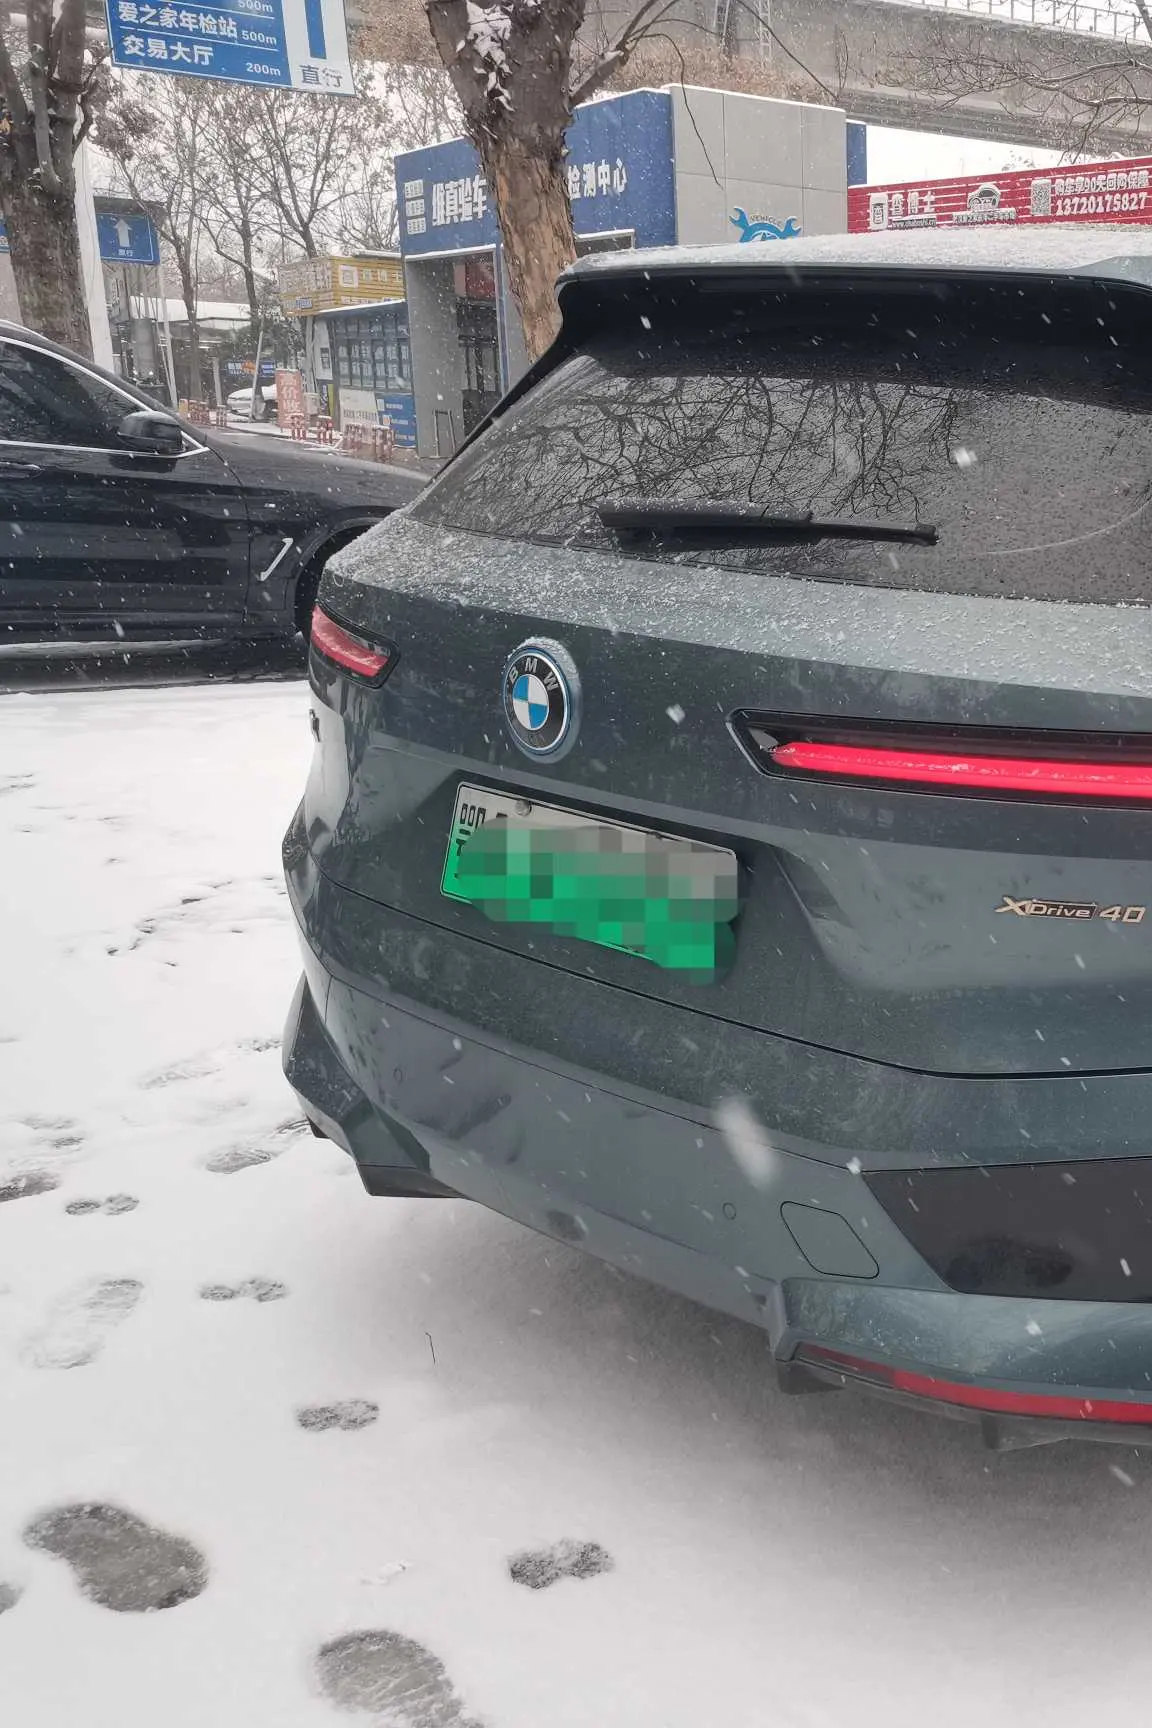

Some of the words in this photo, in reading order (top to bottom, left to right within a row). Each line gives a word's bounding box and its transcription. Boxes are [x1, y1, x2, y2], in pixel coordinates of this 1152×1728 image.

[118, 1, 238, 39] 爱之家年检站
[241, 29, 277, 46] 500m
[122, 34, 214, 66] 交易大厅
[245, 62, 281, 77] 200m
[508, 657, 561, 692] BMW
[1100, 905, 1146, 923] 40
